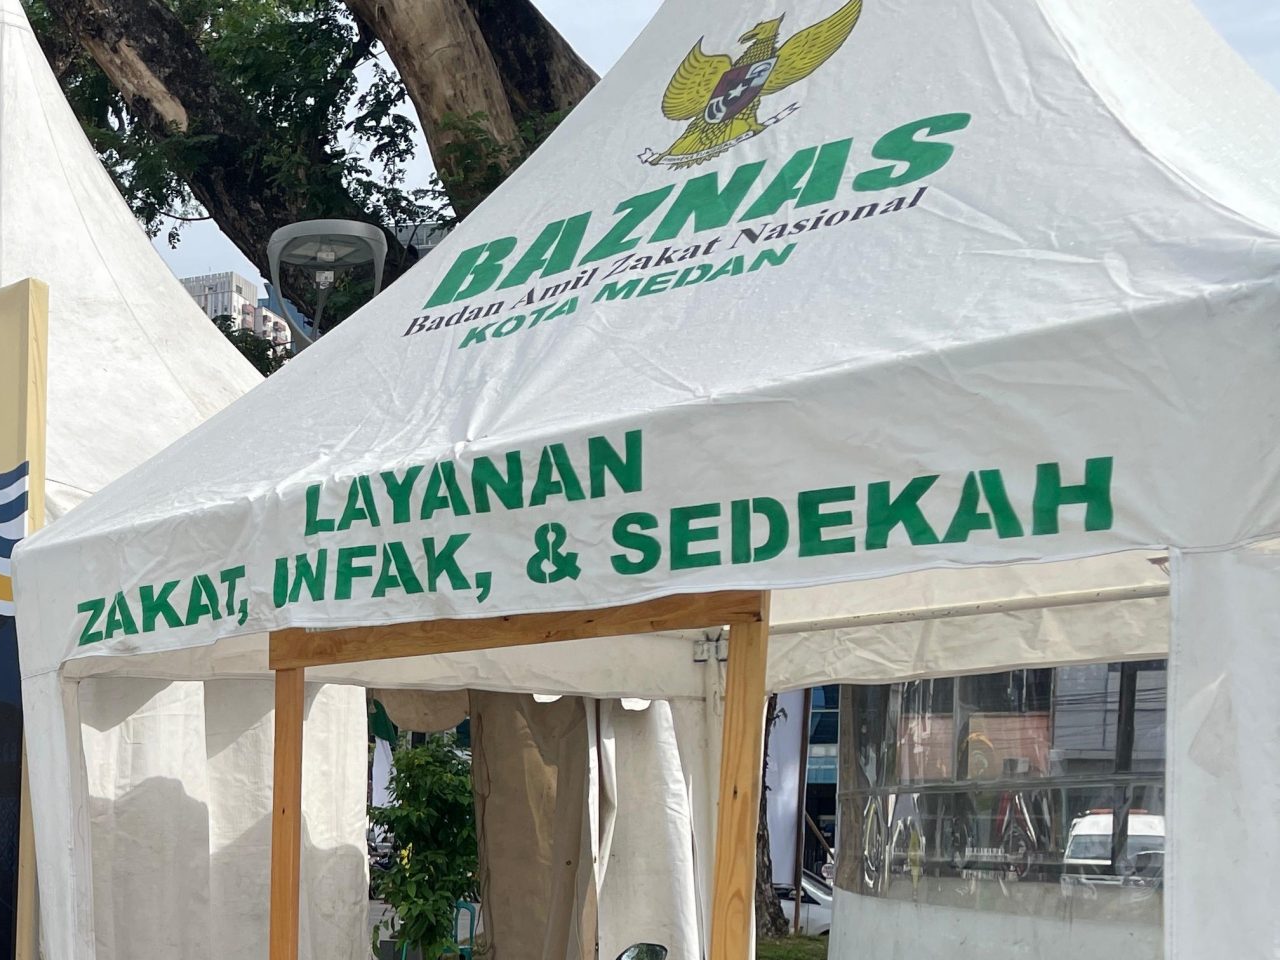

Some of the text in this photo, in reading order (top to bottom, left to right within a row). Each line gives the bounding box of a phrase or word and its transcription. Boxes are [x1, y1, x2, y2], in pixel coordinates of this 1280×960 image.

[402, 187, 929, 338] Badan Amil Zakat Nasional
[423, 112, 972, 310] BAZNAS
[458, 243, 798, 350] KOTA MEDAN
[77, 456, 1114, 647] ZAKAT, INFAK, & SEDEKAH
[304, 429, 643, 537] LAYANAN
